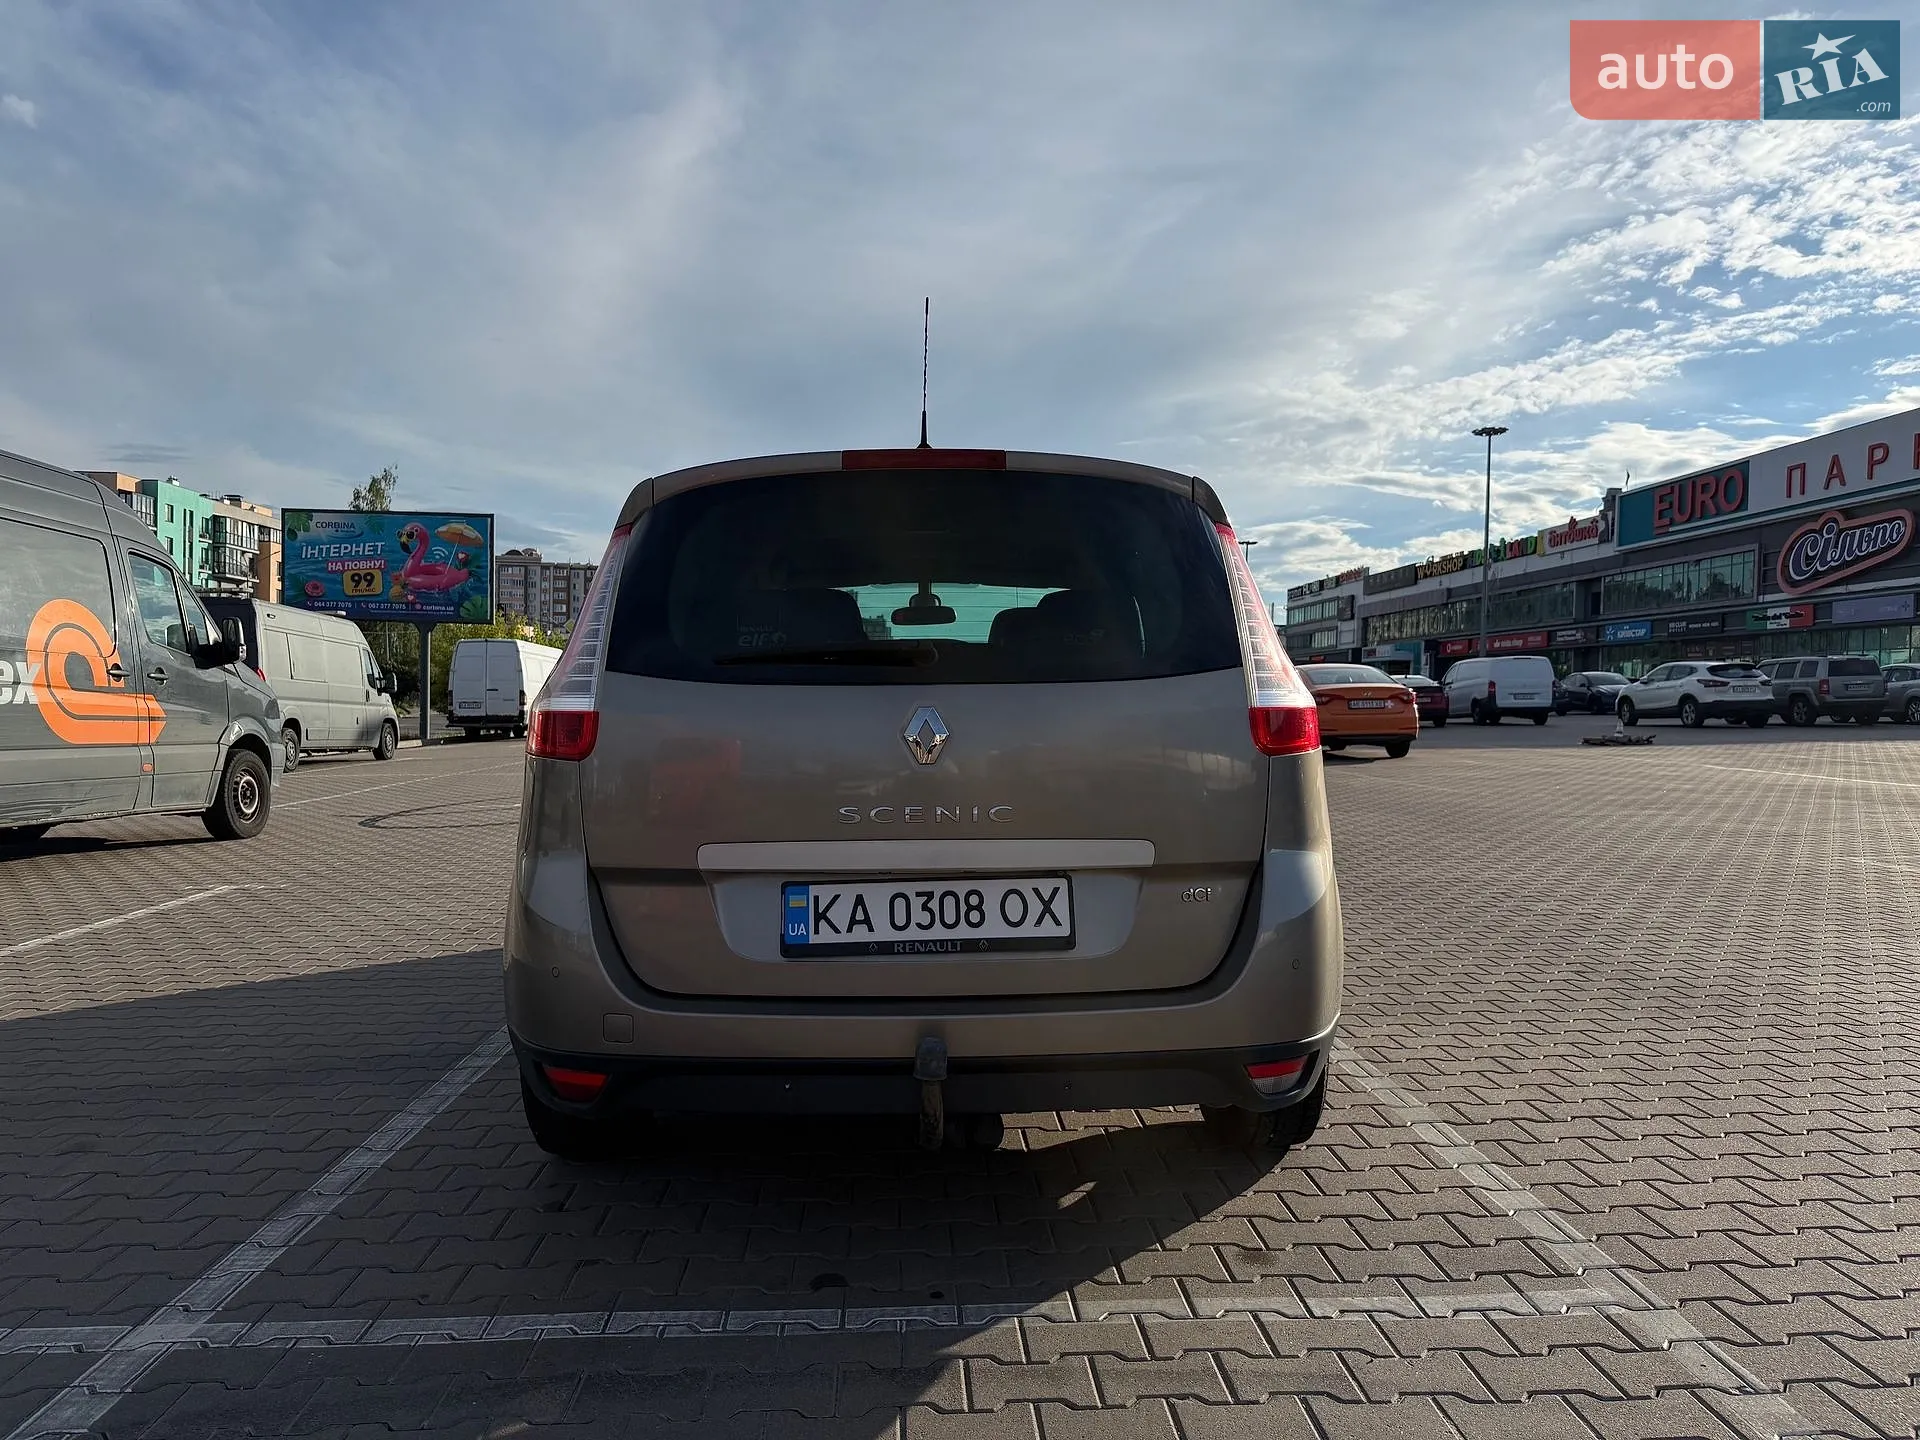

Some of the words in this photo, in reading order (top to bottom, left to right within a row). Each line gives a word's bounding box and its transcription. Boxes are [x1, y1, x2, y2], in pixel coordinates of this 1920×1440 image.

[1653, 468, 1744, 535] EURO
[315, 520, 355, 530] CORBINA
[301, 542, 385, 559] ІНТЕРНЕТ
[1788, 519, 1906, 581] Сільпо
[328, 563, 342, 571] НА
[344, 560, 385, 570] ПОВНУ!
[1417, 556, 1464, 579] WORKSHOP
[350, 572, 376, 589] 99
[838, 805, 1015, 824] SCENIC
[813, 892, 875, 936] KA
[888, 889, 987, 932] 0308
[999, 886, 1063, 929] OX
[788, 923, 807, 937] UA
[894, 940, 962, 953] RENAULT
